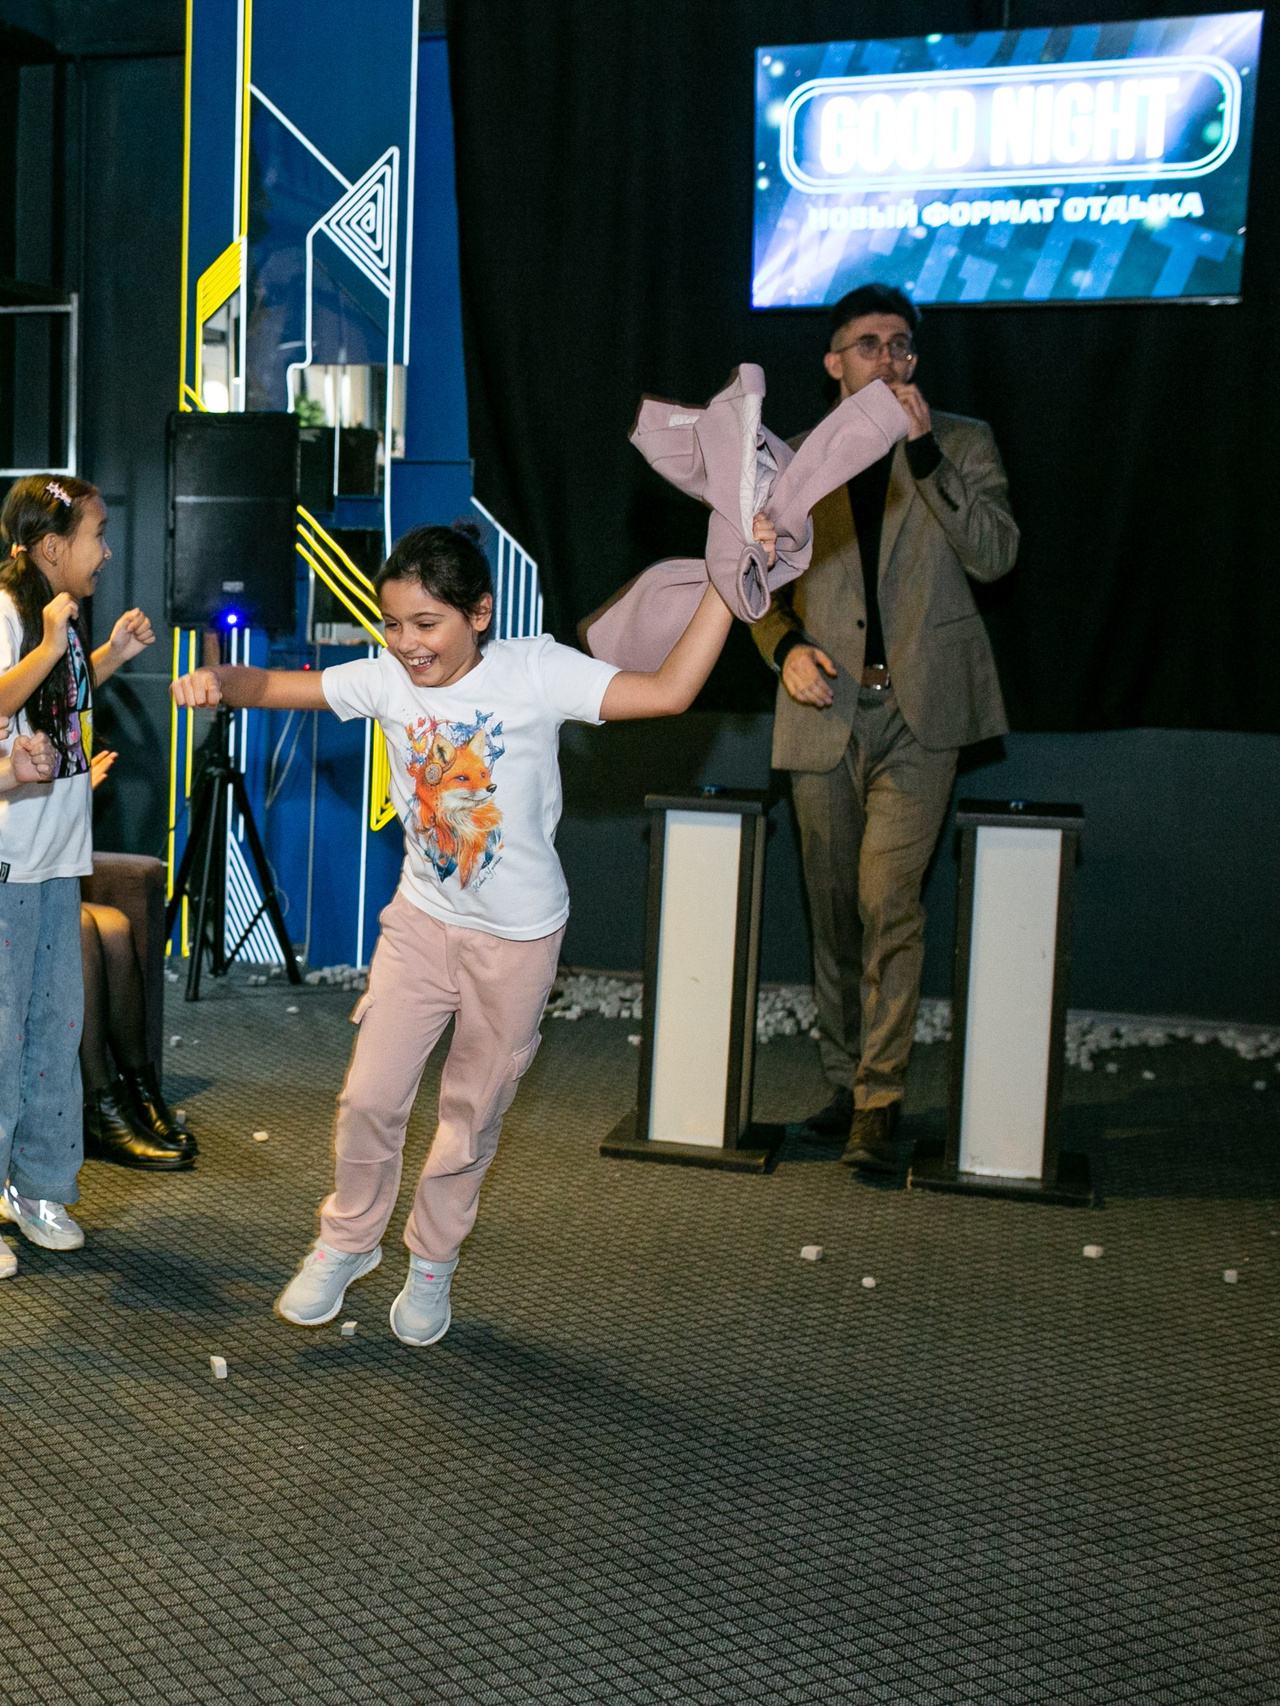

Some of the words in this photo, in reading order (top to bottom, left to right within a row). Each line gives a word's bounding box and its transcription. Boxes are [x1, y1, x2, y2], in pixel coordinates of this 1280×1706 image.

[820, 91, 977, 174] GOOD
[989, 77, 1181, 166] NIGHT
[808, 199, 918, 231] НОВЫЙ
[921, 197, 1061, 228] ФОРМАТ
[1062, 192, 1205, 225] ОТДЫХА
